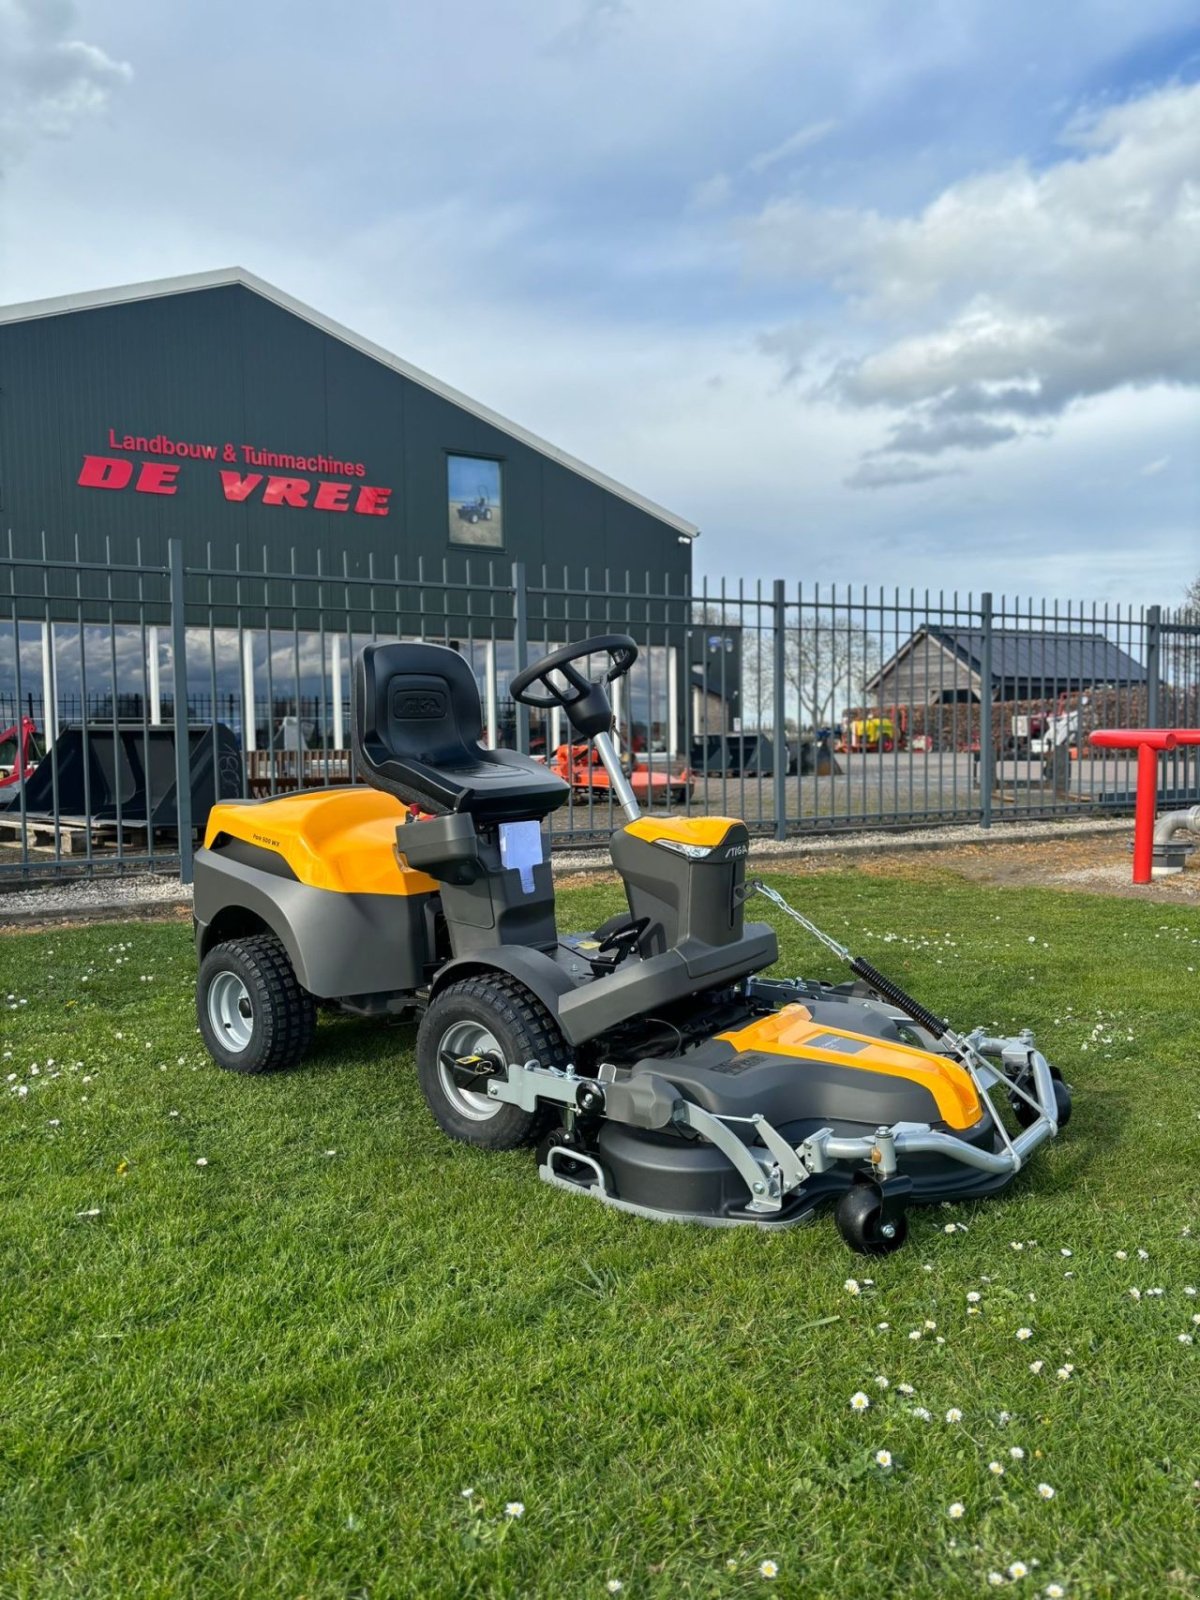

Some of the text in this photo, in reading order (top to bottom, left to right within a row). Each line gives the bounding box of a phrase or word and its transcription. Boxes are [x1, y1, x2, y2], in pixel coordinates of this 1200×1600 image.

[109, 429, 366, 477] Landbouw & Tuinmachines
[77, 455, 393, 516] DE VREE
[725, 845, 747, 858] STIGA
